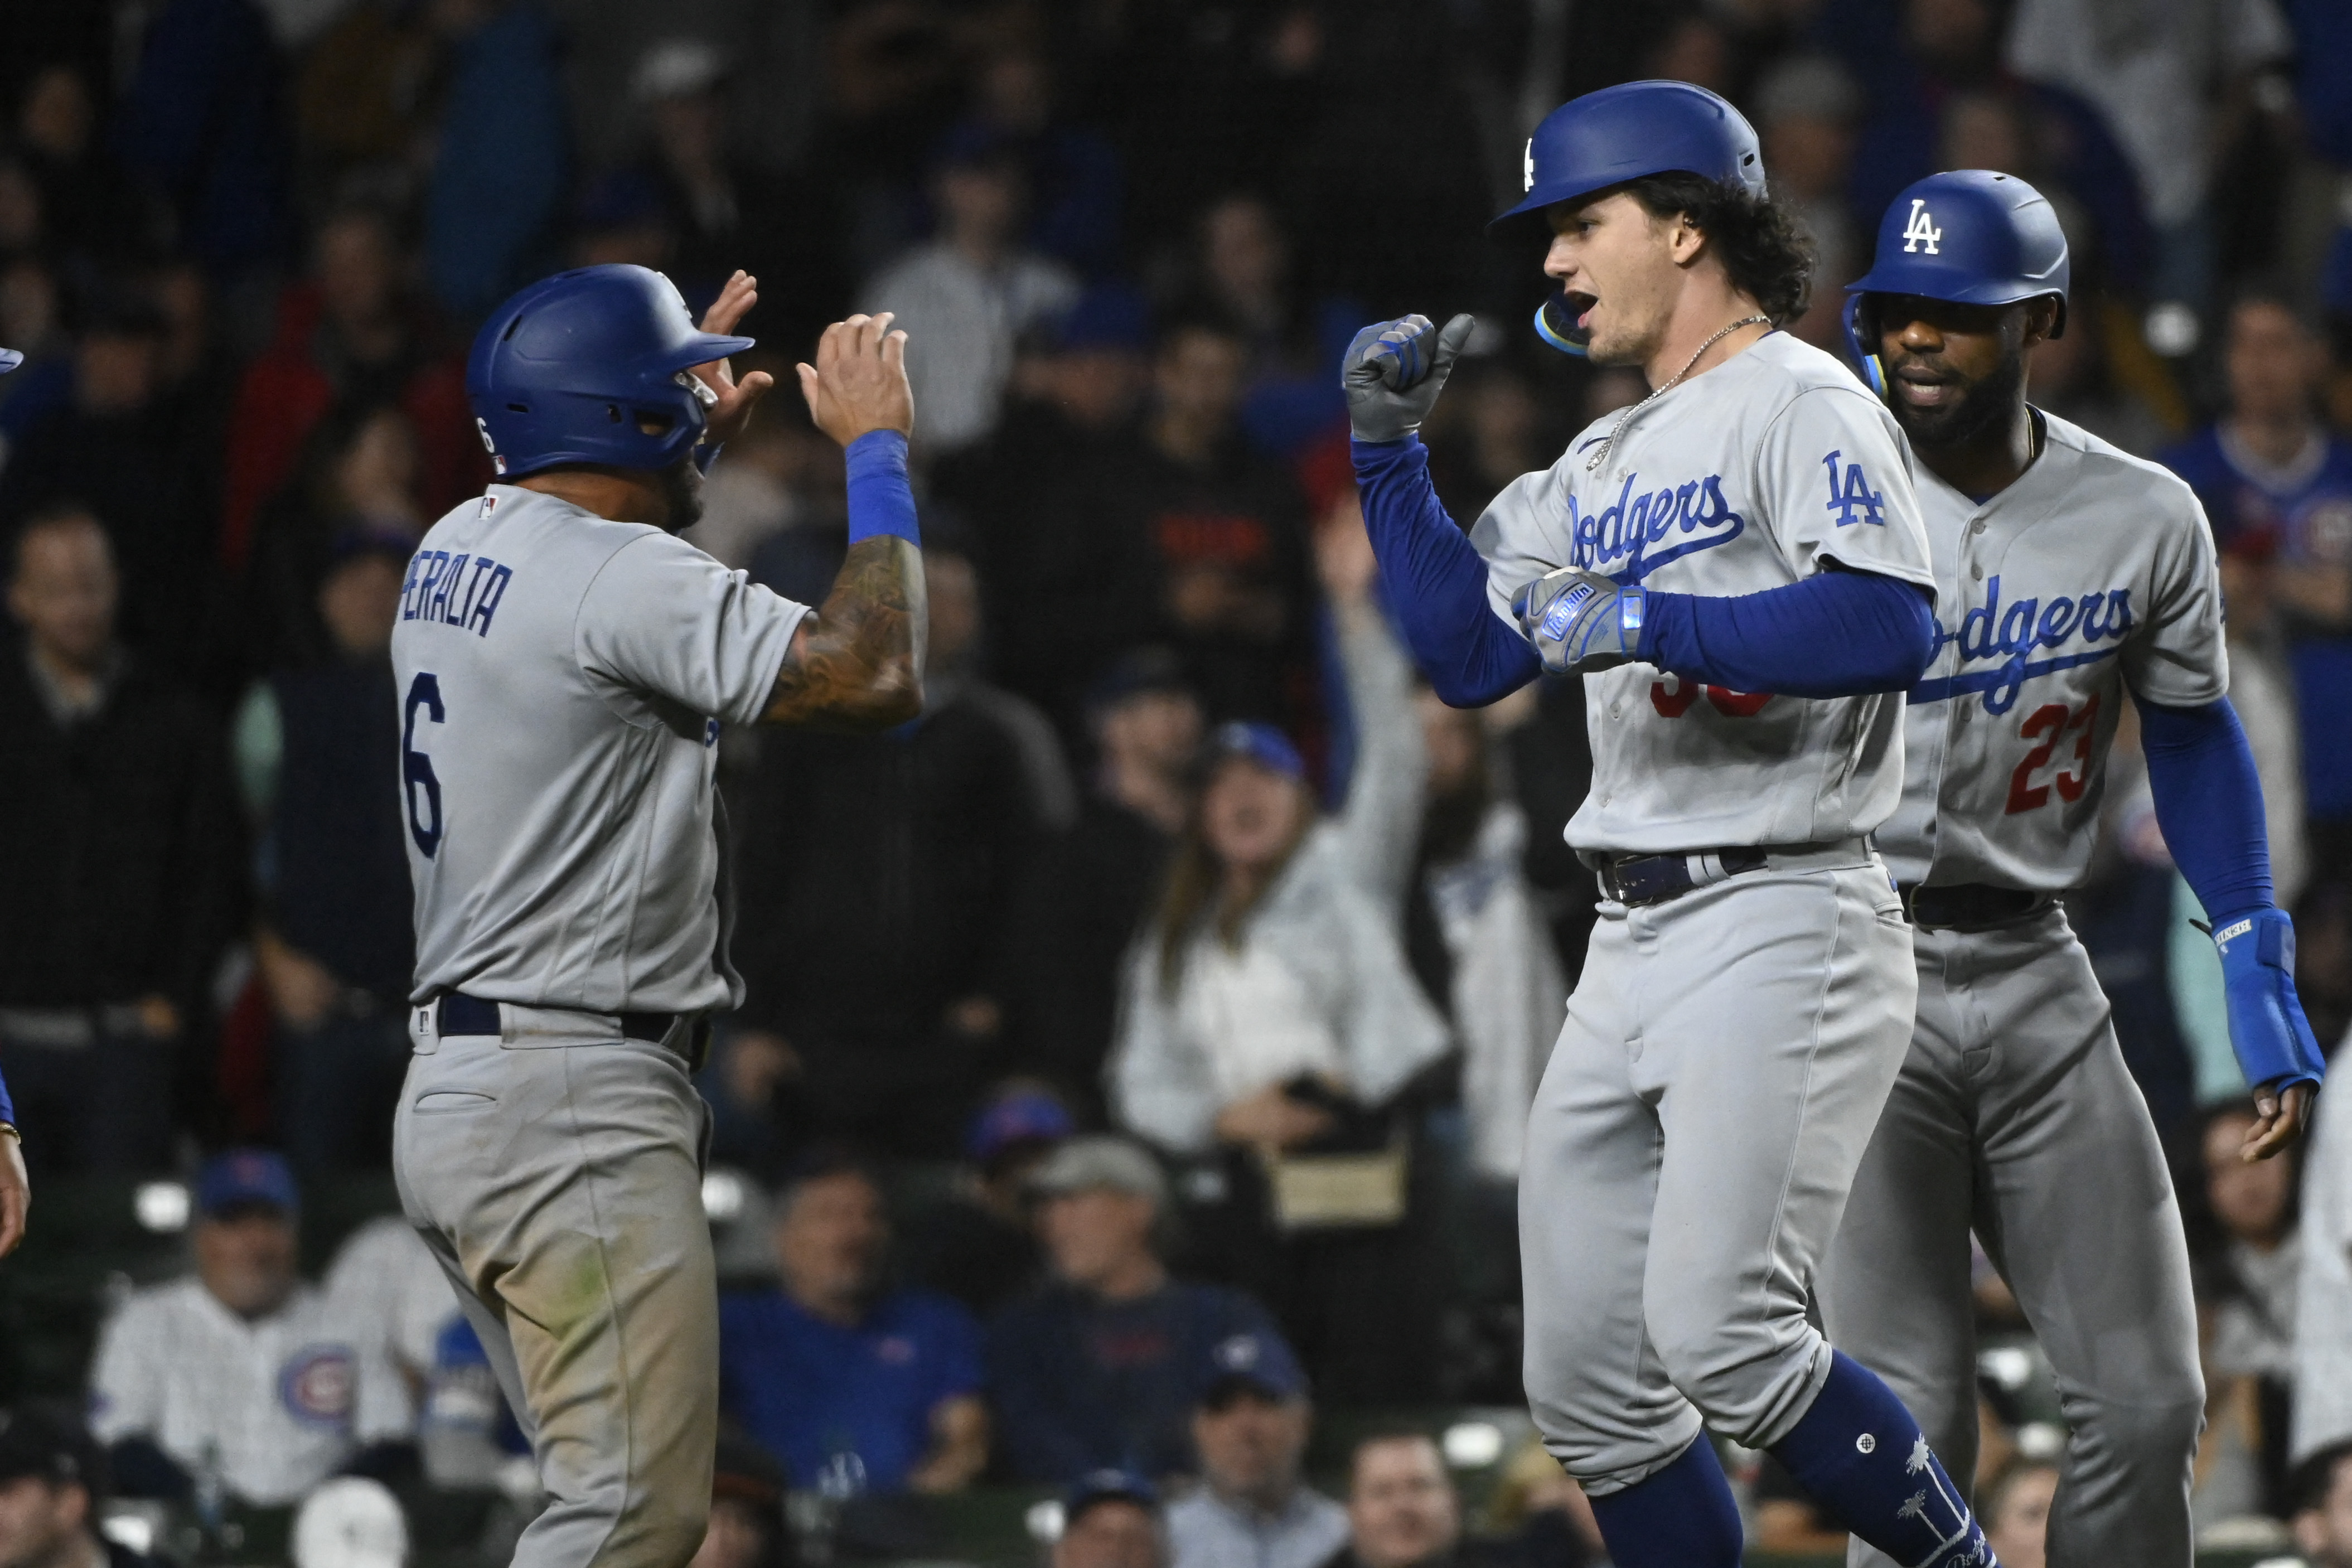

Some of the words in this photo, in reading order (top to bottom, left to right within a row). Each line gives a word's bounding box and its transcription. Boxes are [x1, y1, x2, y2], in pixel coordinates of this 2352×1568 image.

[1903, 199, 1942, 255] LA
[477, 417, 495, 454] 6
[1822, 449, 1885, 528] LA
[403, 672, 445, 859] 6
[2004, 693, 2101, 815] 23
